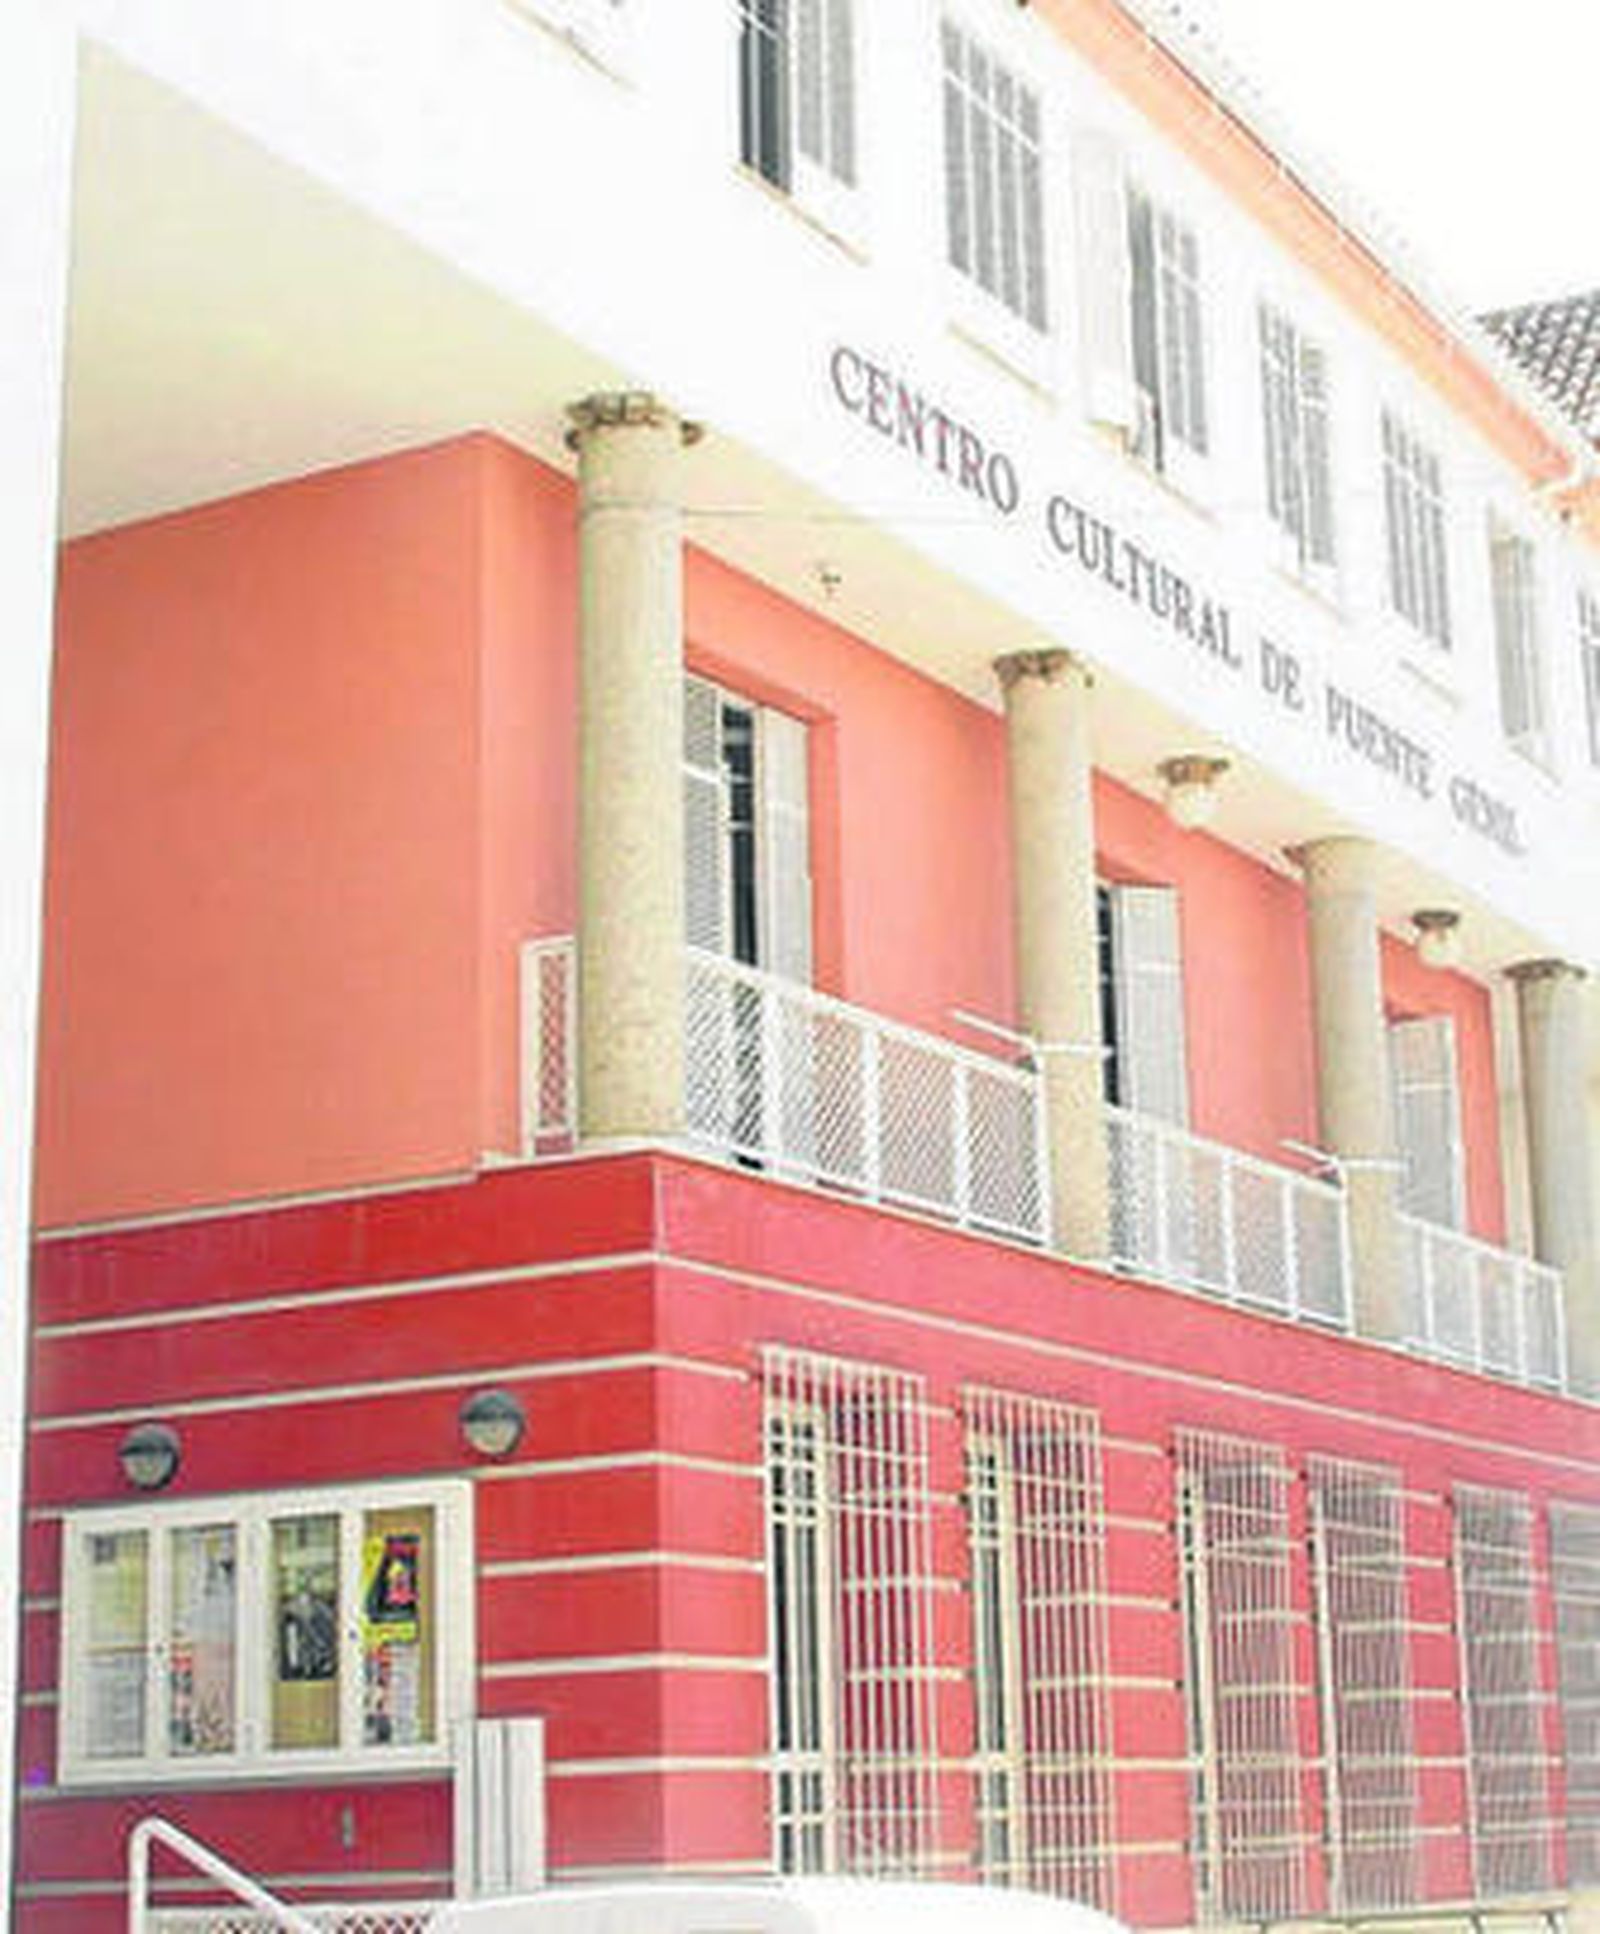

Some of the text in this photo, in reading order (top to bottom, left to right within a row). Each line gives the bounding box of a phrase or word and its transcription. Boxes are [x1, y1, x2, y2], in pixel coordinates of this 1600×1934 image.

[830, 347, 1019, 514] CENTRO
[1047, 495, 1242, 670] CULTURAL
[1260, 635, 1304, 711] DE
[1325, 684, 1436, 800] PUENTE
